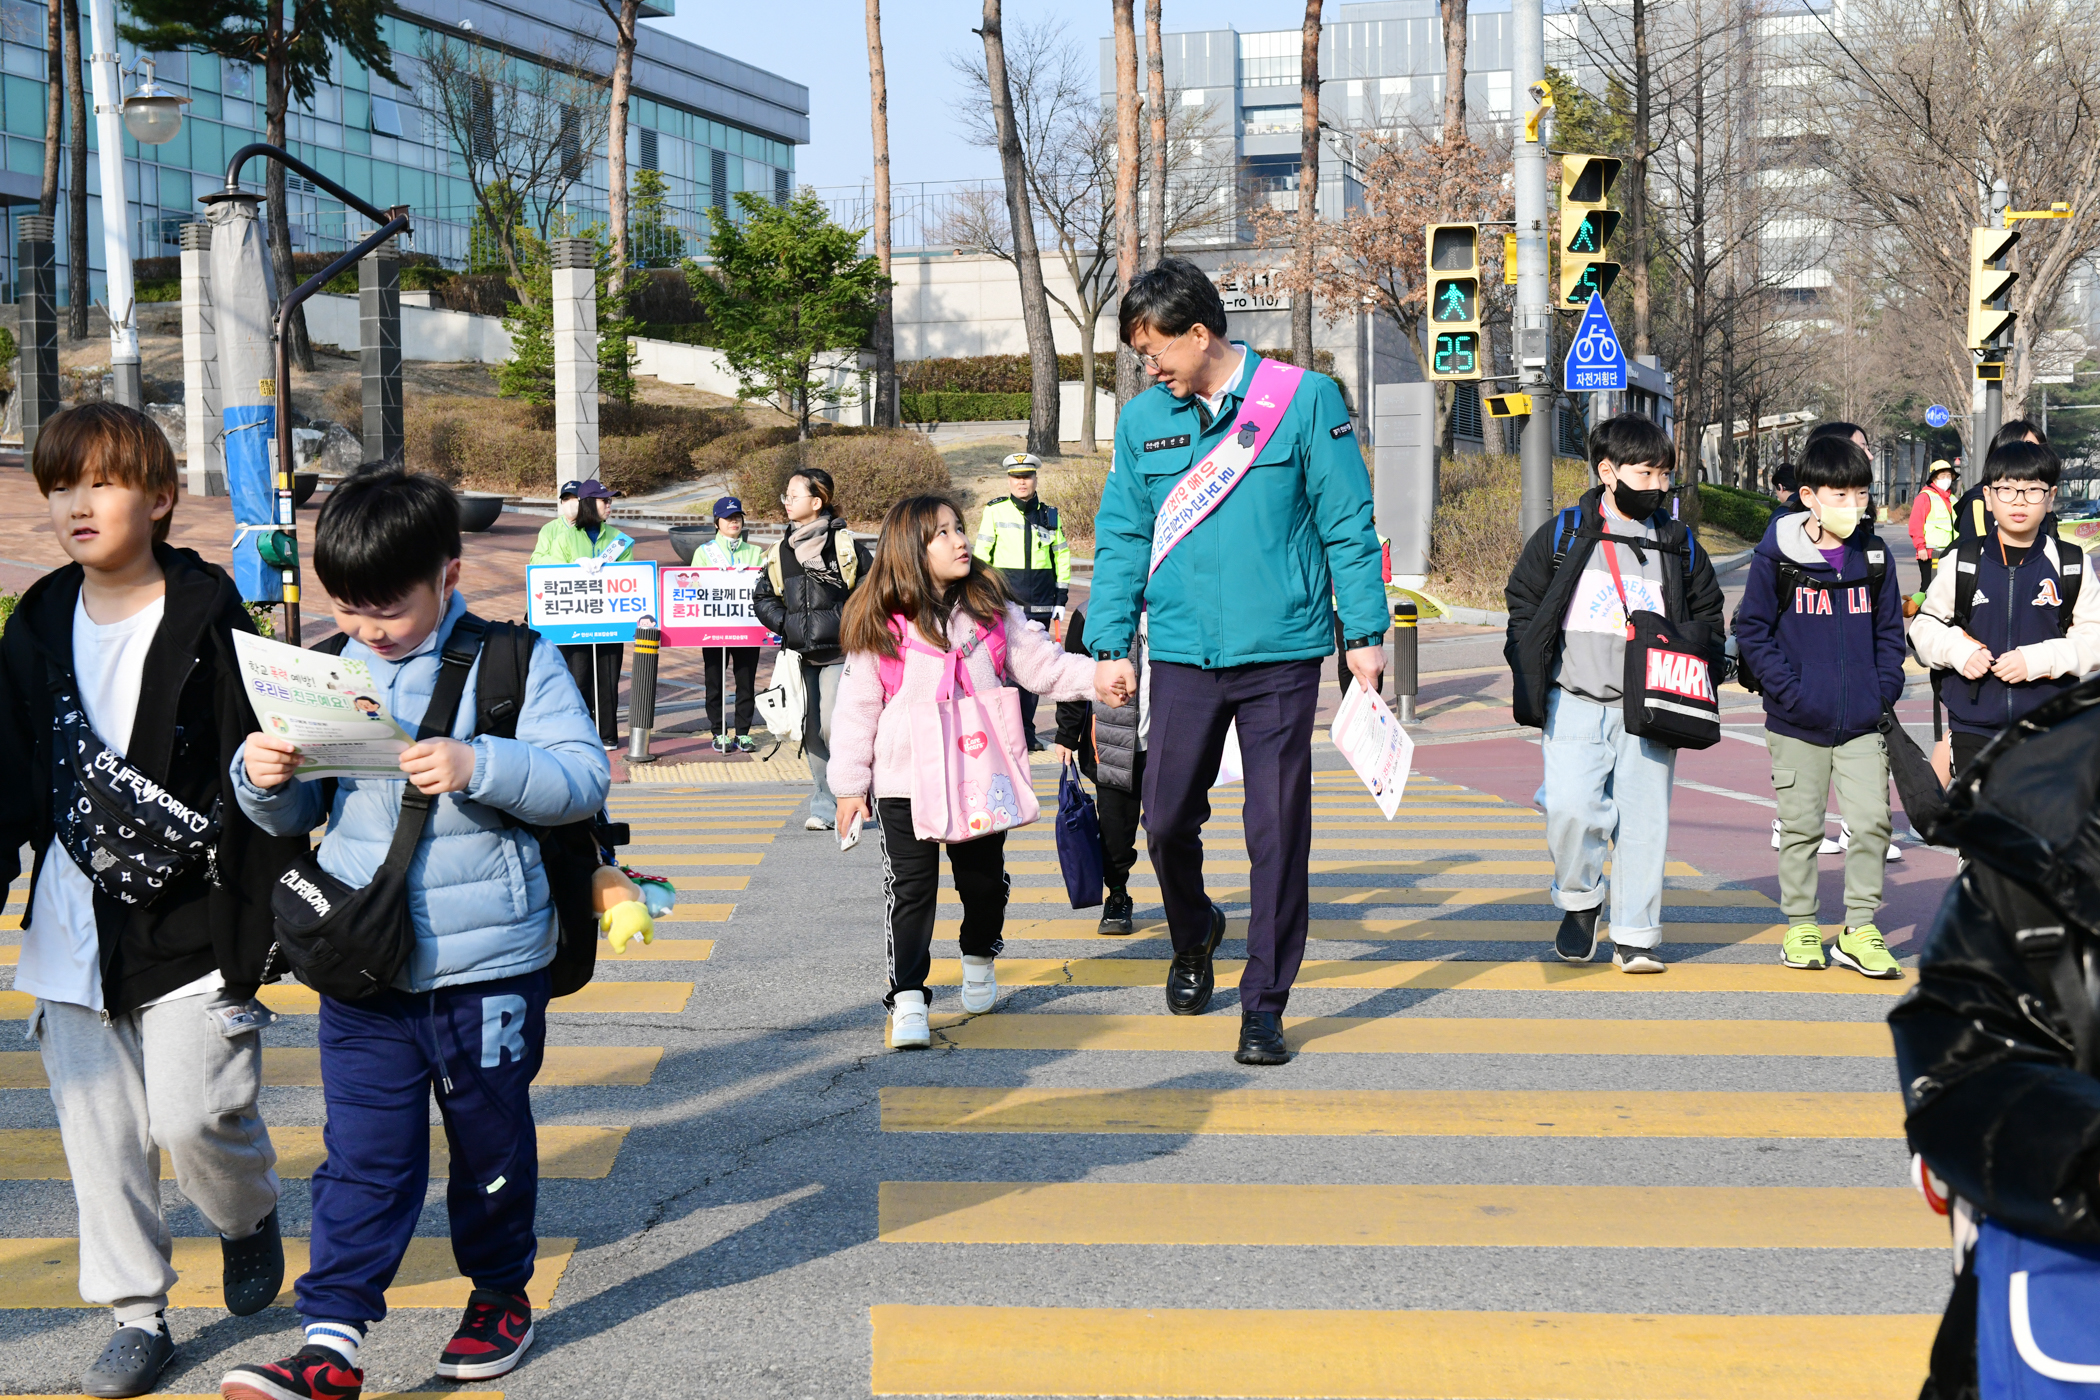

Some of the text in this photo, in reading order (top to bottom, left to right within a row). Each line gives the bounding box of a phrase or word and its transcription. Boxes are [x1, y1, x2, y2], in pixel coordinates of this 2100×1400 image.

[1436, 335, 1473, 371] 25
[1576, 371, 1618, 387] 자전거횡단
[1167, 460, 1218, 515] 아동 안전
[544, 578, 637, 596] 학교폭력 NO!
[672, 588, 709, 601] 친구와
[712, 588, 736, 601] 함께
[544, 597, 647, 615] 친구사랑 YES!
[673, 603, 700, 618] 혼자
[703, 603, 743, 618] 다니지
[248, 660, 316, 688] 학교 폭력 예방!
[254, 680, 349, 710] 우리는 친구예요!
[107, 760, 195, 824] LIFEWORK
[286, 874, 332, 917] LIFEWORK
[481, 994, 527, 1068] R
